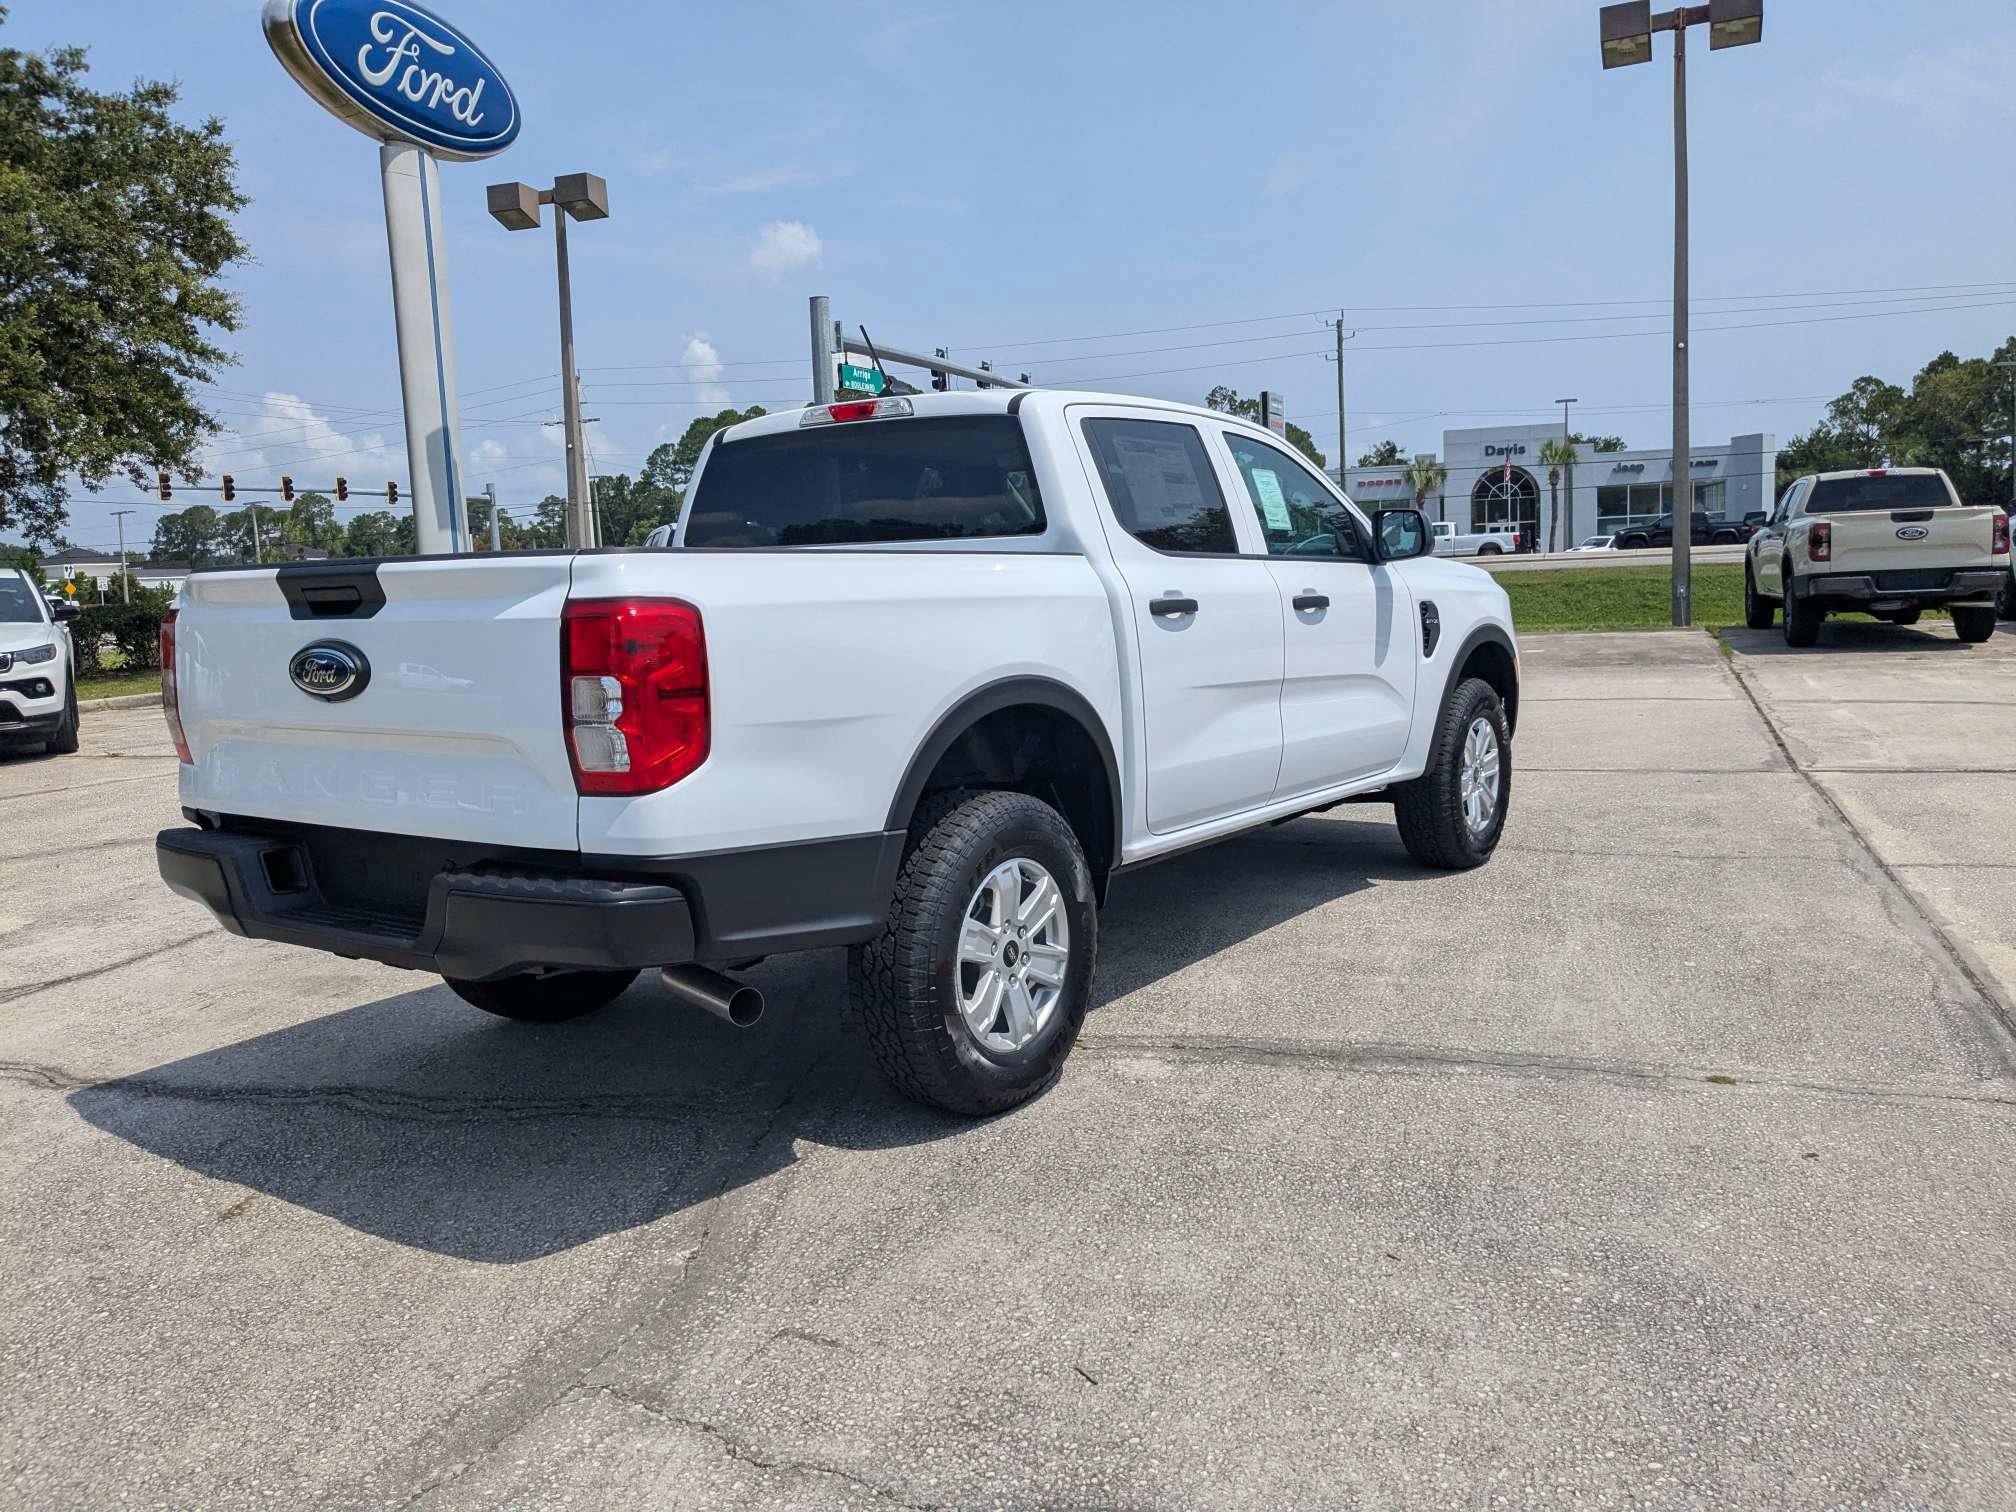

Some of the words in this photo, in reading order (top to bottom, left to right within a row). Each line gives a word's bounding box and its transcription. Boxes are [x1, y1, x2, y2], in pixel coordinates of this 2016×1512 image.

[358, 11, 486, 127] Ford
[1484, 443, 1526, 457] Davis
[1612, 462, 1645, 474] Jeep
[1357, 478, 1402, 488] DODGE
[303, 658, 336, 682] Ford
